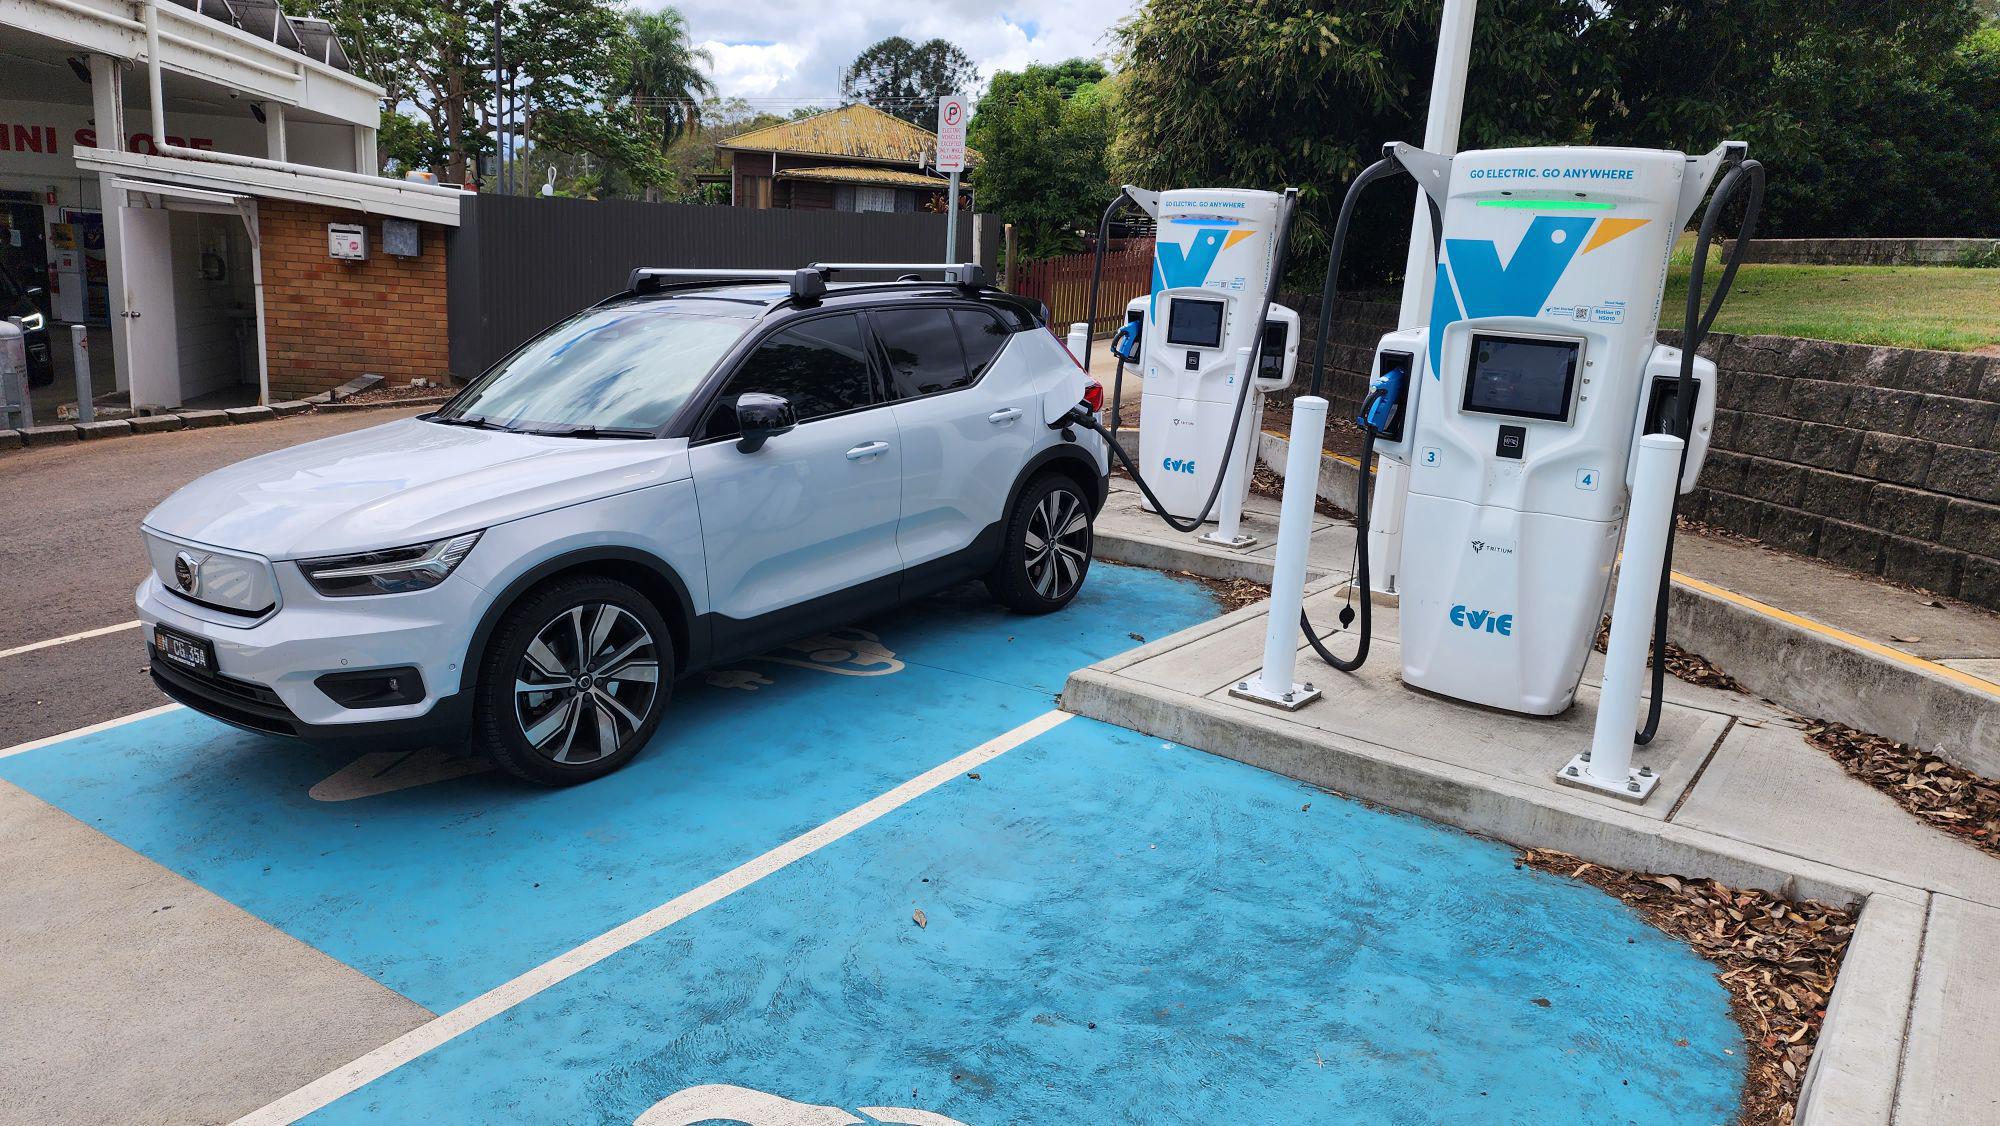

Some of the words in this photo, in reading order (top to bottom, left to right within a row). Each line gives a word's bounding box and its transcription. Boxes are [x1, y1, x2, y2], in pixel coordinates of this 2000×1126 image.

[1470, 169, 1484, 179] GO
[1486, 168, 1539, 179] ELECTRIC.
[1542, 168, 1561, 178] GO
[1563, 168, 1635, 180] ANYWHERE
[1210, 201, 1246, 209] ANYWHERE
[1229, 376, 1234, 384] 2
[1427, 451, 1435, 463] 3
[1582, 474, 1592, 486] 4
[1487, 545, 1513, 554] TRITIUM
